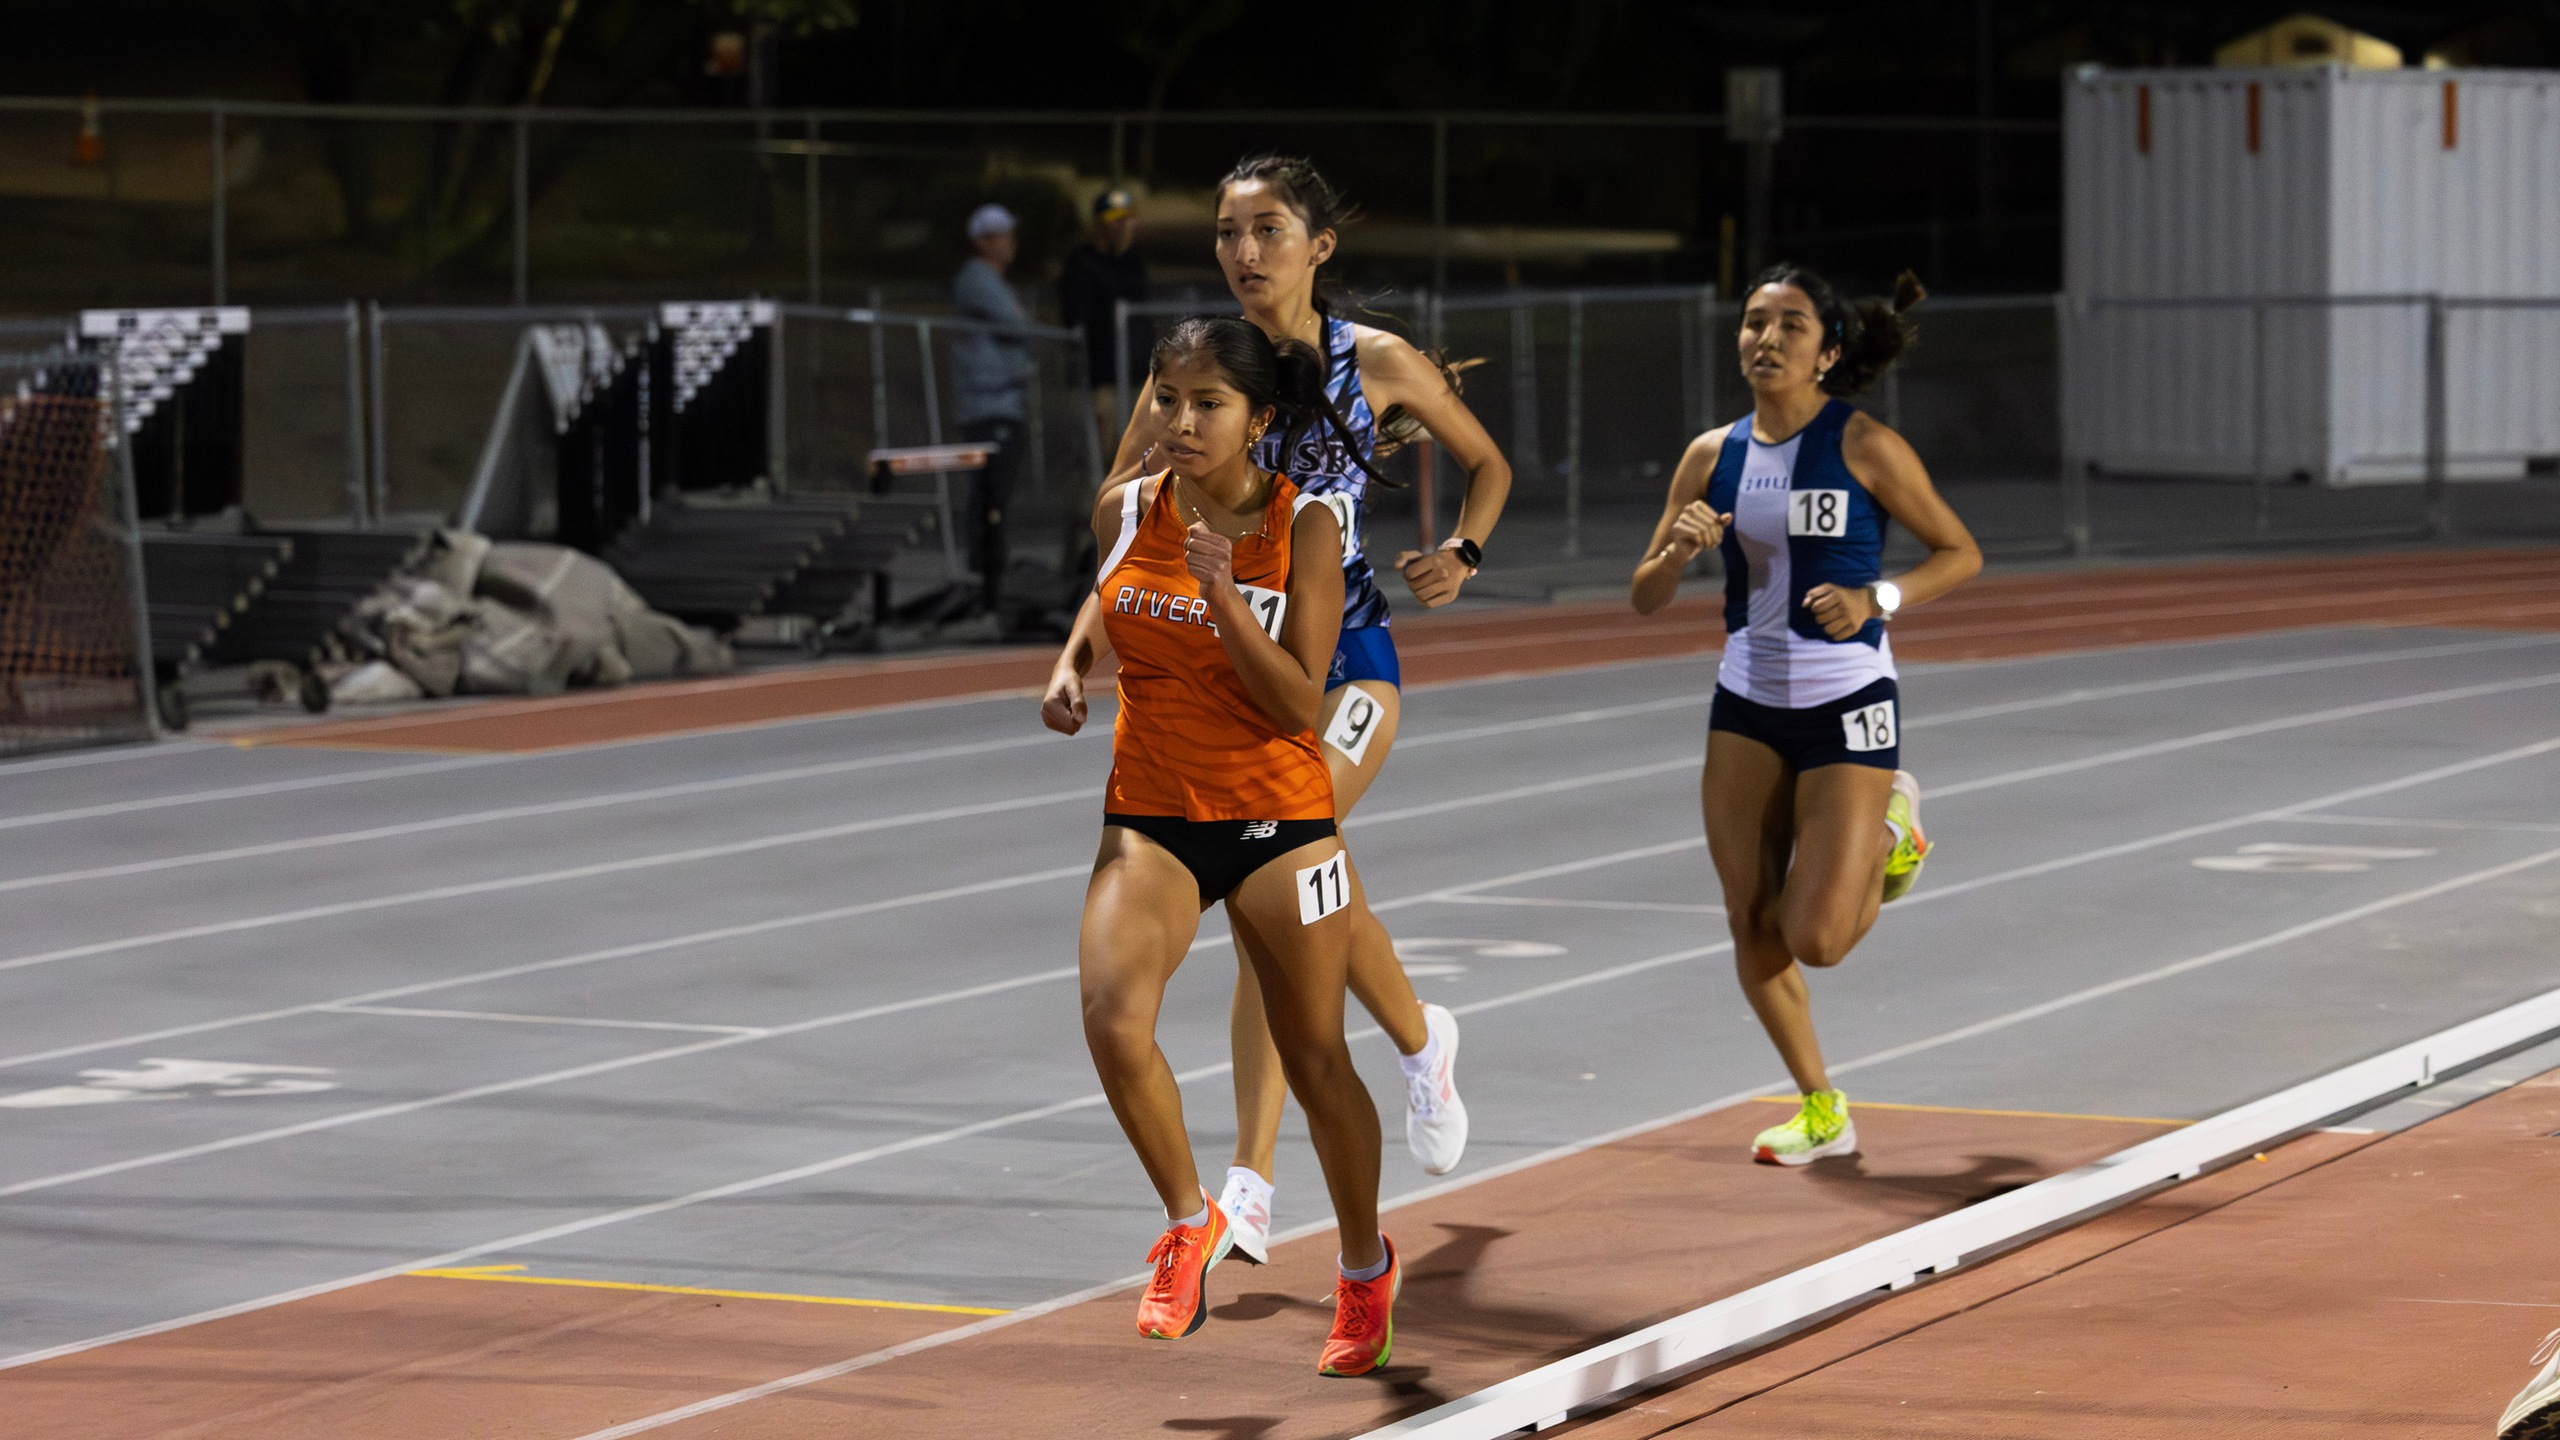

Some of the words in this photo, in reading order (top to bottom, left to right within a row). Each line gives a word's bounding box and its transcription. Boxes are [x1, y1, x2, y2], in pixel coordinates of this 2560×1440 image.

[1798, 492, 1837, 533] 18
[1113, 585, 1219, 628] RIVER
[1337, 696, 1374, 750] 9
[1853, 706, 1889, 748] 18
[1308, 860, 1342, 916] 11
